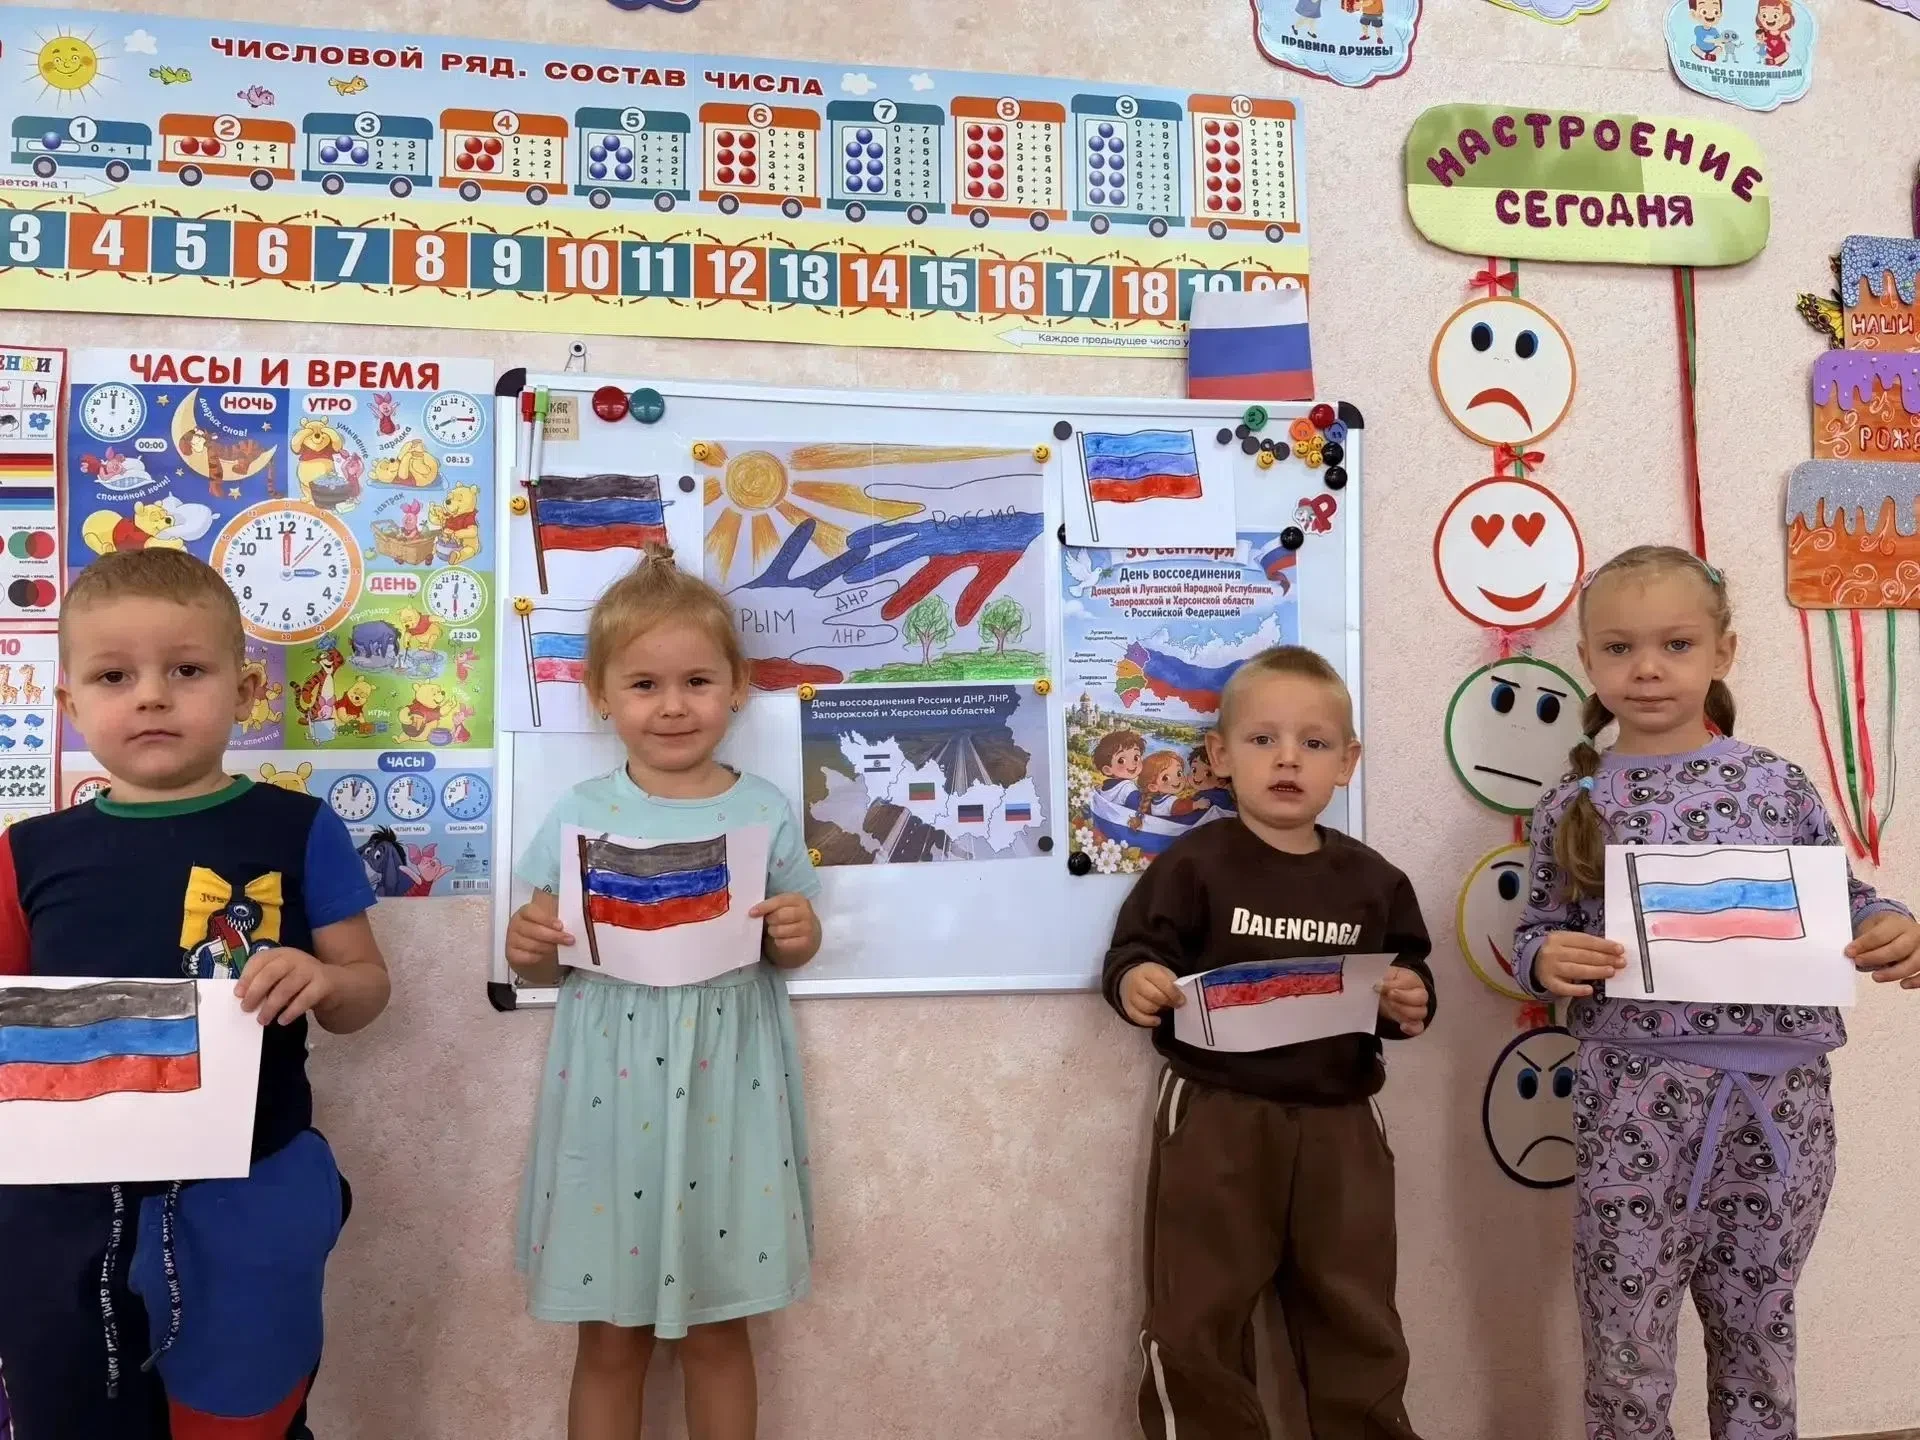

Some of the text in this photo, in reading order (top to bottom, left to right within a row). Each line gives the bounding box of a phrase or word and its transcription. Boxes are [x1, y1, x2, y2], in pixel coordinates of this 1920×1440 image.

[1281, 35, 1393, 56] ПРАВИЛА ДРУЖБЫ
[210, 37, 824, 96] ЧИСЛОВОЙ РЯД. СОСТАВ ЧИСЛА
[1679, 59, 1803, 79] ДЕЛИТЬСЯ С ТОВАРИЩАМИ
[1711, 75, 1770, 86] ИГРУШКАМИ
[879, 105, 892, 119] 7
[1002, 102, 1016, 116] 8
[1121, 100, 1133, 113] 9
[1233, 99, 1251, 113] 10
[498, 115, 512, 130] 4
[625, 112, 640, 127] 5
[753, 108, 767, 123] 6
[76, 122, 86, 138] 1
[220, 119, 235, 136] 2
[360, 117, 376, 133] 3
[1426, 112, 1764, 203] НАСТРОЕНИЕ
[42, 181, 58, 189] на
[59, 195, 74, 205] +1
[141, 200, 156, 209] +1
[223, 205, 238, 213] +1
[304, 210, 318, 219] +1
[1495, 189, 1694, 227] СЕГОДНЯ
[382, 212, 396, 221] +1
[459, 216, 474, 225] +1
[535, 220, 549, 230] +1
[611, 225, 625, 234] +1
[9, 213, 41, 263] 3
[92, 218, 125, 266] 4
[175, 222, 207, 271] 5
[257, 227, 289, 275] 6
[336, 231, 369, 278] 7
[414, 234, 446, 282] 8
[493, 239, 522, 286] 9
[557, 242, 610, 290] 10
[631, 246, 675, 292] 11
[706, 249, 757, 295] 12
[779, 253, 829, 301] 13
[849, 257, 900, 304] 14
[919, 261, 968, 307] 15
[988, 264, 1036, 311] 16
[1055, 267, 1104, 313] 17
[1122, 271, 1168, 316] 18
[1851, 313, 1914, 336] НАШИ
[1038, 333, 1079, 343] Каждое
[1082, 336, 1147, 346] предыдущее
[130, 354, 440, 390] ЧАСЫ И ВРЕМЯ
[224, 396, 274, 411] НОЧЬ
[308, 397, 352, 412] УТРО
[199, 398, 248, 437] добрых снов!
[138, 441, 164, 449] 00:00
[336, 422, 370, 459] умывание
[379, 426, 412, 451] зарядка
[445, 455, 470, 464] 08:15
[96, 475, 171, 501] спокойной ночи!
[374, 492, 405, 516] завтрак
[932, 504, 1017, 532] РОССИЯ
[256, 527, 272, 540] 11
[278, 521, 296, 534] 12
[305, 528, 314, 540] 1
[239, 543, 256, 556] 10
[323, 543, 332, 556] 2
[236, 564, 245, 577] 9
[328, 565, 337, 577] 3
[1120, 568, 1241, 582] День воссоединения
[370, 577, 417, 592] ДЕНЬ
[1091, 585, 1130, 597] Донецкой
[1139, 584, 1182, 595] Луганской
[1184, 583, 1223, 594] Народной
[243, 586, 252, 599] 8
[322, 587, 332, 599] 4
[836, 590, 868, 611] ДНР
[1110, 597, 1164, 607] Запорожской
[1173, 596, 1220, 606] Херсонской
[1222, 596, 1254, 605] области
[259, 603, 268, 616] 7
[282, 608, 291, 621] 6
[306, 603, 315, 616] 5
[349, 607, 390, 622] прогулка
[1131, 607, 1183, 618] Российской
[1186, 607, 1241, 618] Федерацией
[738, 608, 795, 634] РЫМ
[453, 631, 478, 639] 12:30
[832, 629, 866, 643] ЛНР
[811, 699, 837, 708] День
[839, 697, 915, 708] воссоединения
[918, 695, 952, 704] России
[963, 695, 986, 705] ДНР,
[988, 694, 1010, 703] ЛНР,
[368, 709, 391, 718] игры
[812, 709, 879, 720] Запорожской
[890, 708, 948, 718] Херсонской
[951, 706, 996, 715] областей
[386, 756, 425, 768] ЧАСЫ
[1230, 907, 1362, 946] BALENCIAGA
